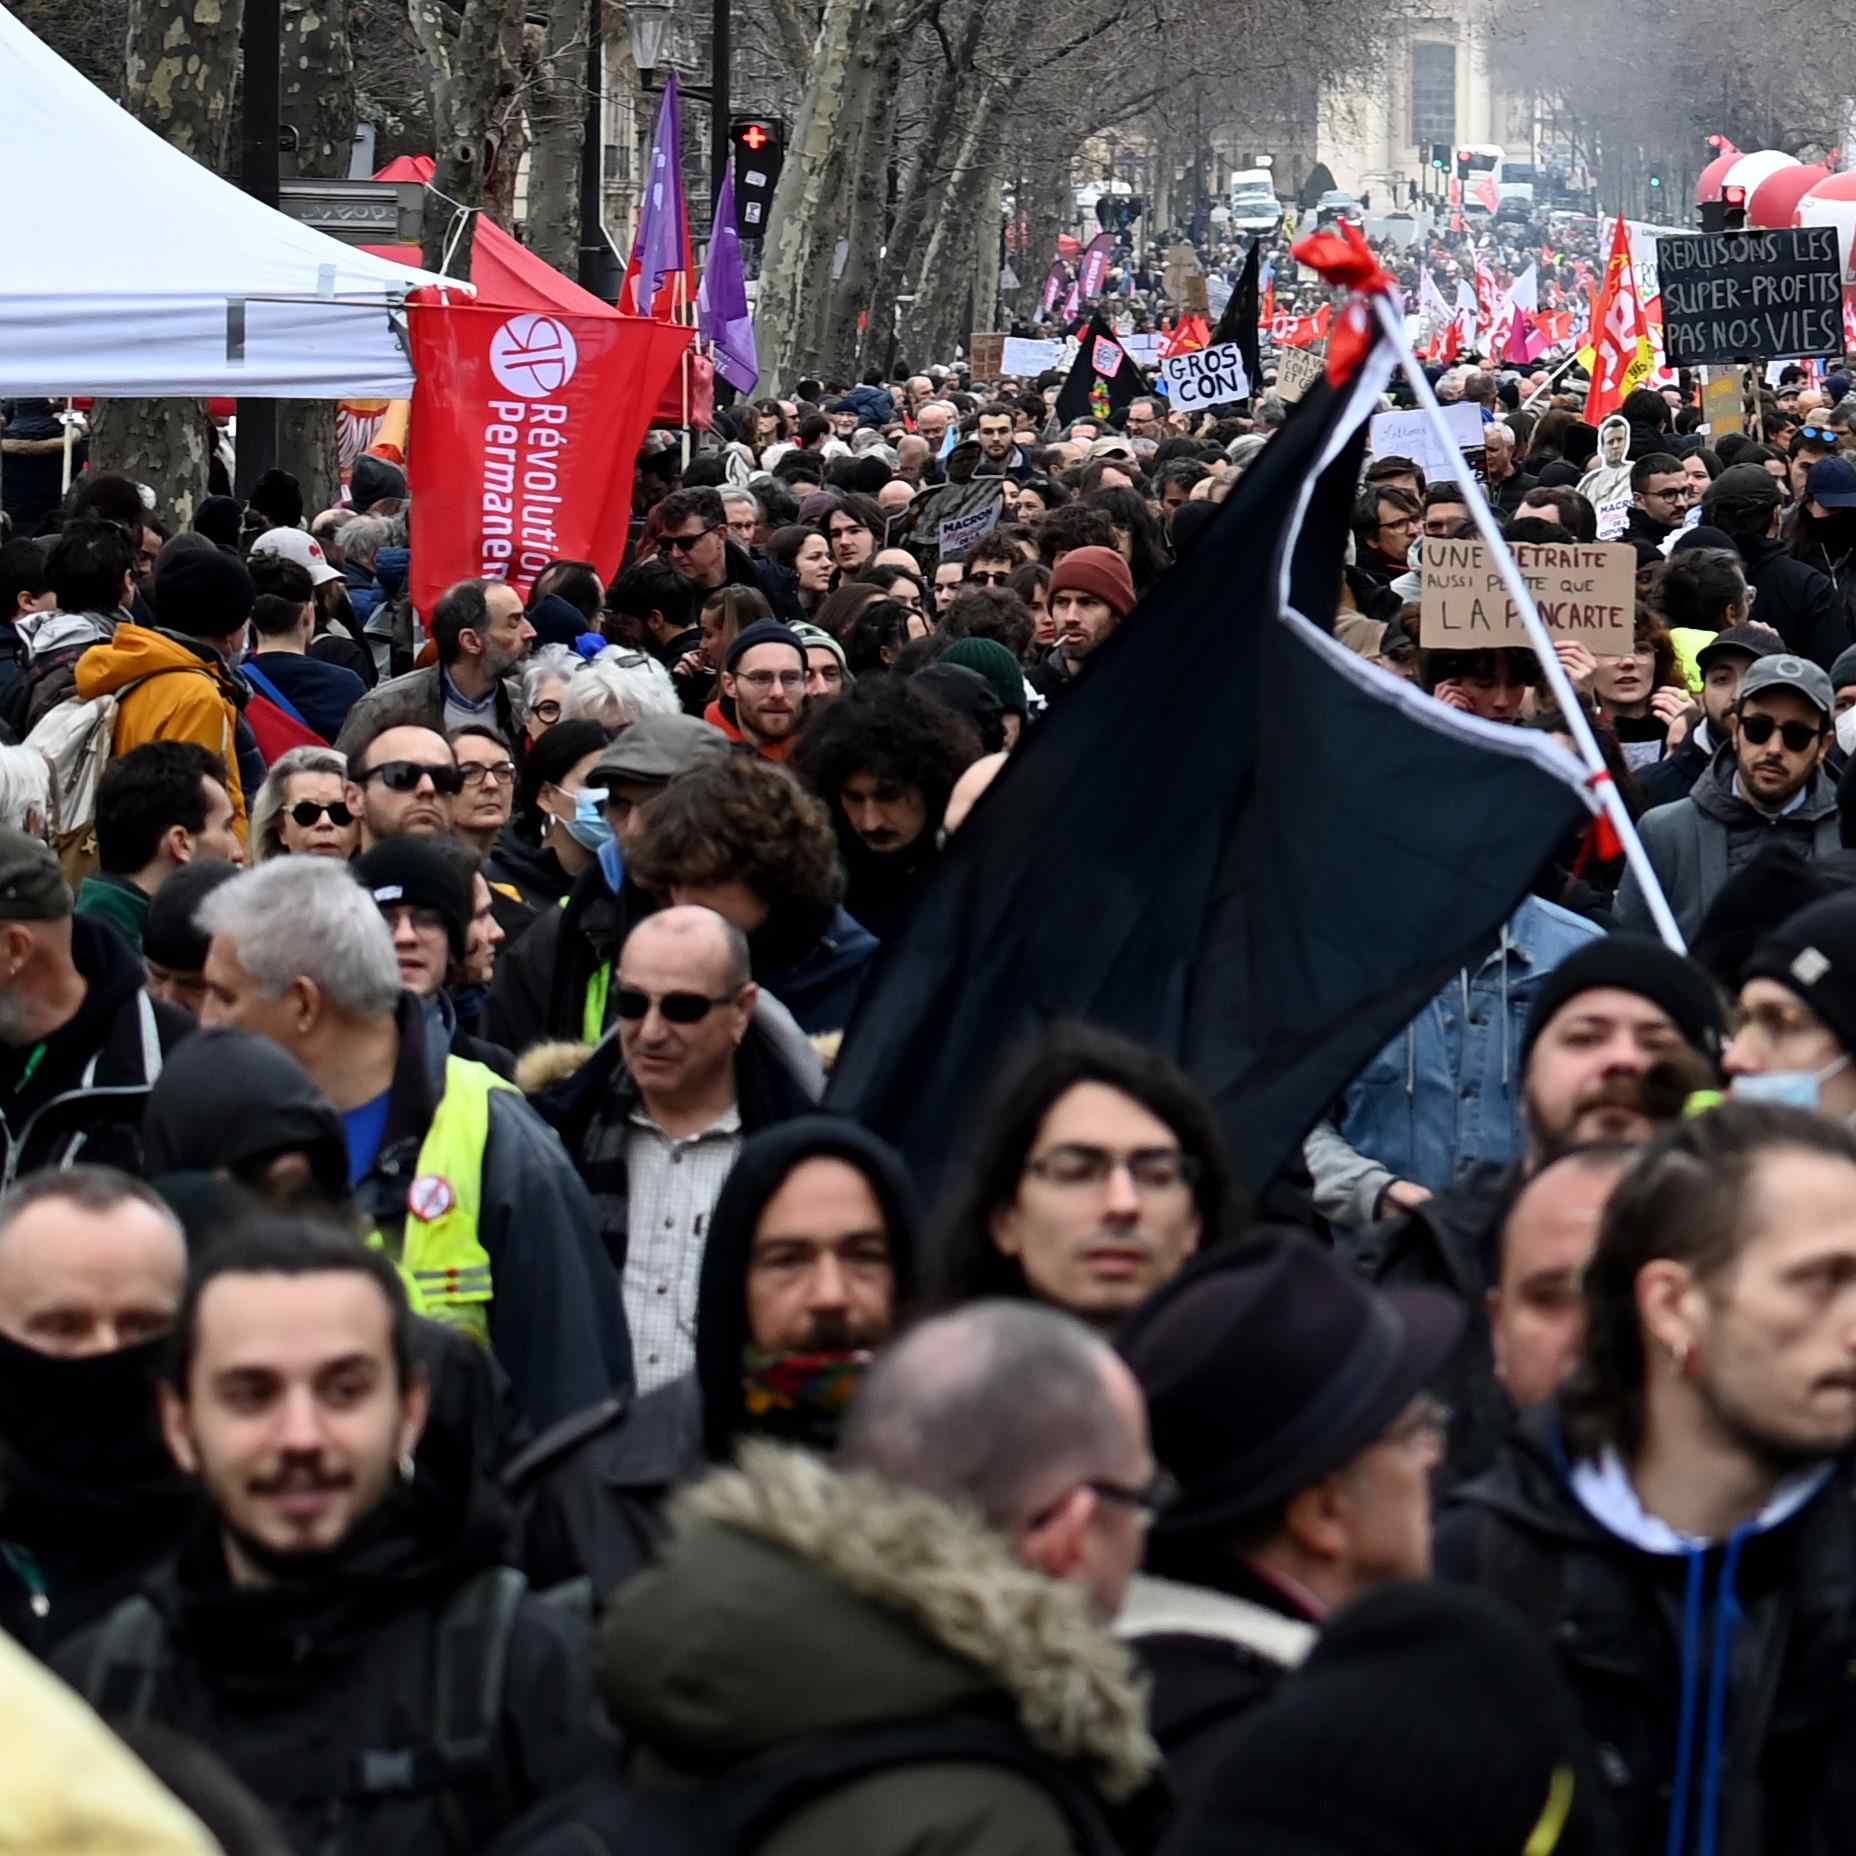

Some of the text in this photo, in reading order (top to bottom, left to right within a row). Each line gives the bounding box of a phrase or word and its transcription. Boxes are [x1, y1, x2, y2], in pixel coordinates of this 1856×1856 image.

[1792, 229, 1834, 263] LES
[1663, 271, 1842, 315] SUPER-PROFITS
[1667, 321, 1706, 357] PAS
[1711, 318, 1762, 350] NOS
[1764, 308, 1838, 352] VIES
[1169, 344, 1237, 380] GROS
[1178, 368, 1239, 402] CON
[943, 506, 993, 534] MACRON
[1427, 544, 1609, 569] UNE ETRAiTE
[1427, 573, 1473, 589] AUSSI
[1559, 578, 1596, 594] QUE
[1441, 597, 1625, 631] LA PNCARTE
